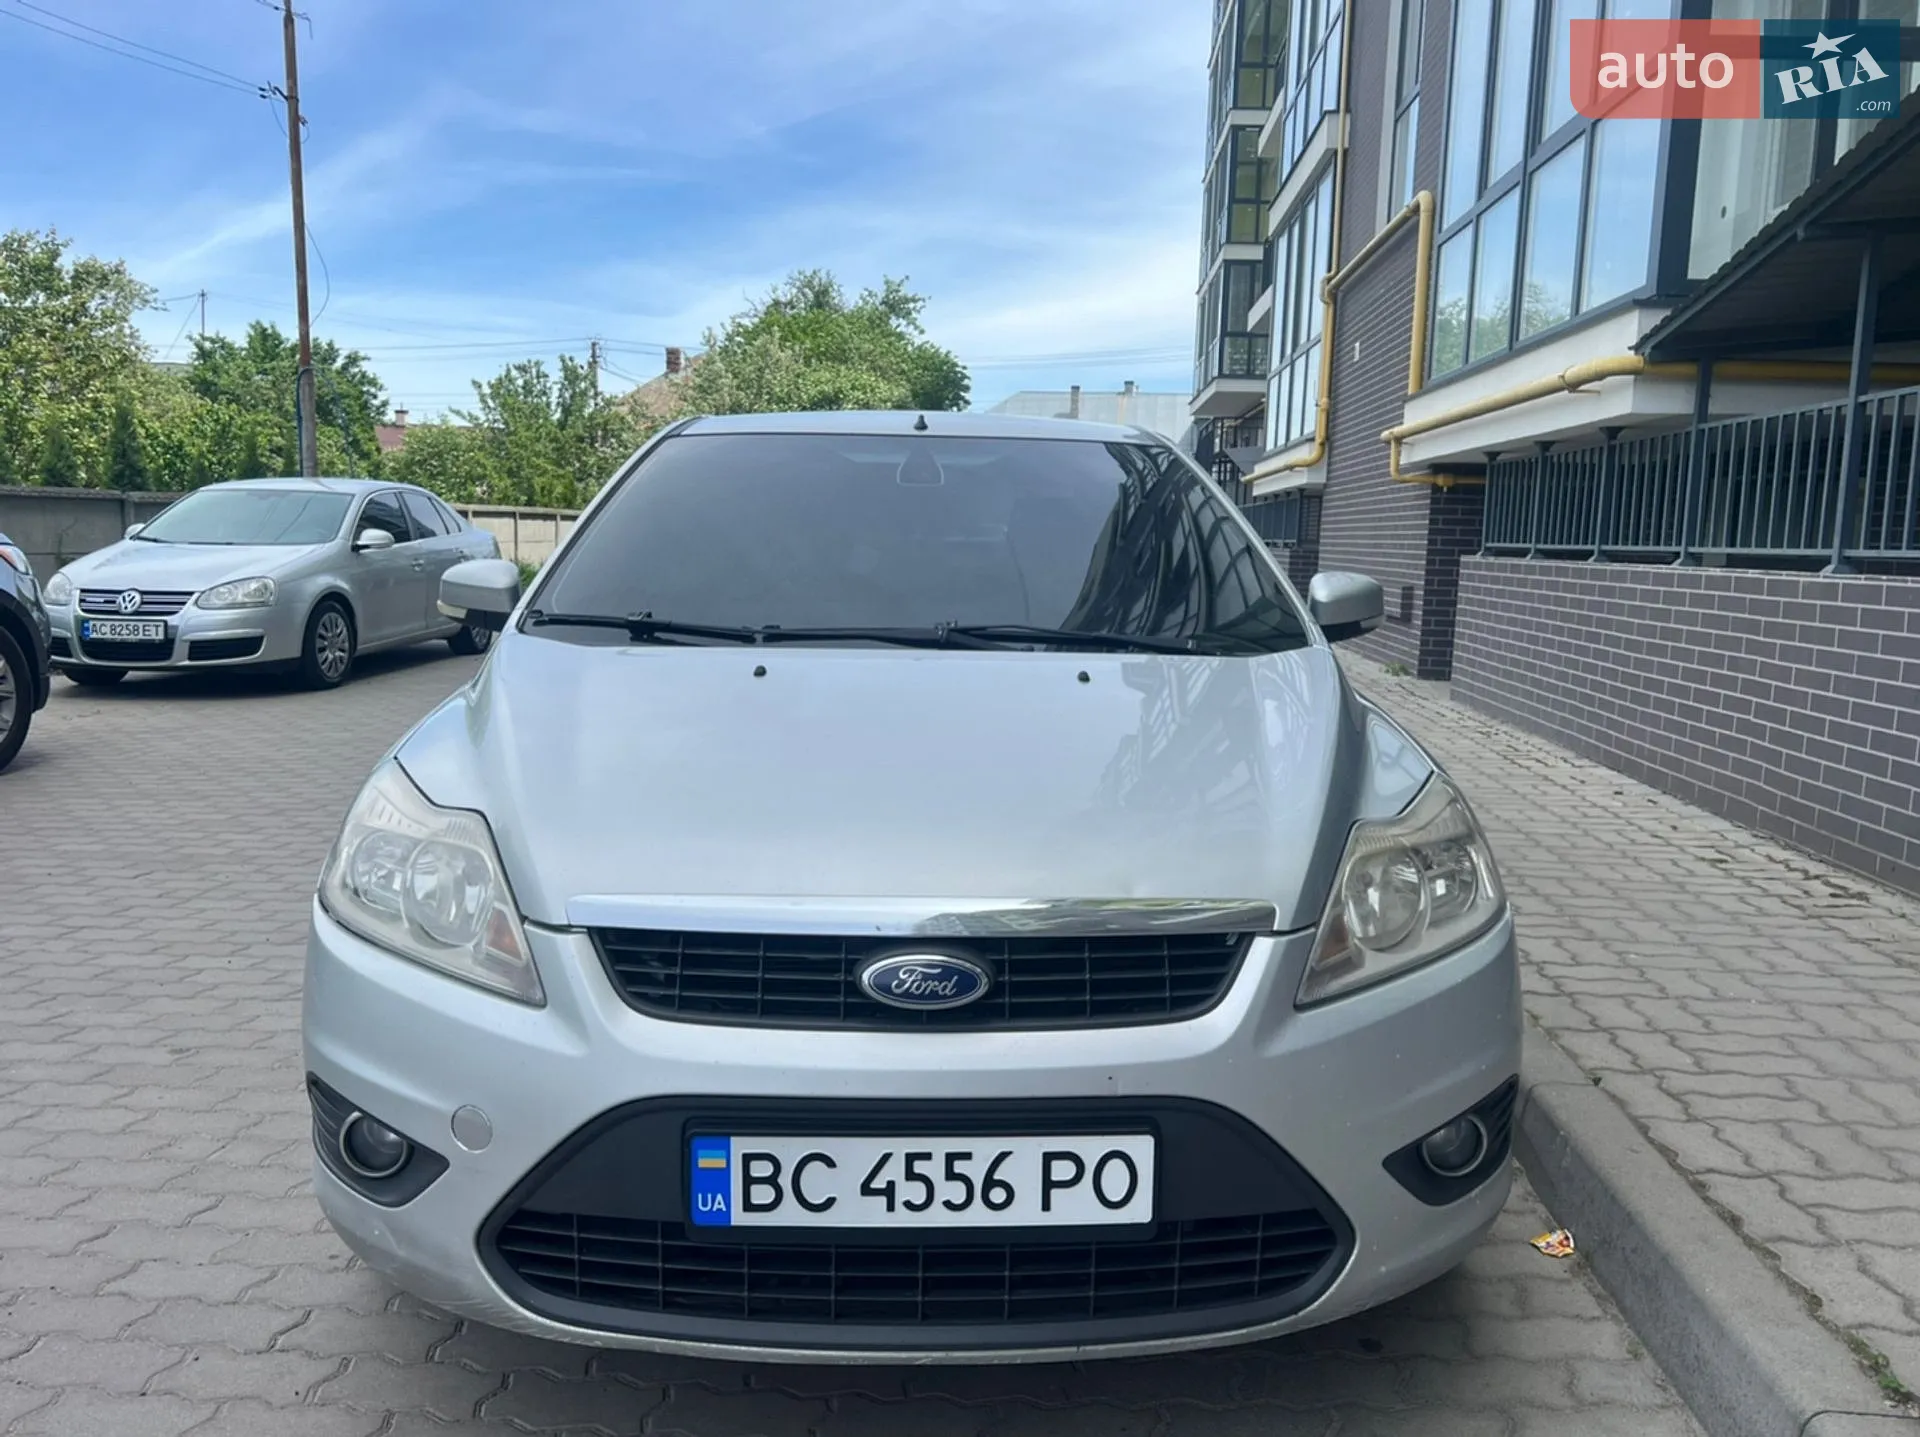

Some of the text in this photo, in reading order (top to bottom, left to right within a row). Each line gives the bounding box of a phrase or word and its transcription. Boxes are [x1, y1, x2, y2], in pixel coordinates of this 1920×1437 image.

[91, 623, 161, 637] AC 8258 ET
[891, 965, 959, 996] Ford
[741, 1149, 1139, 1213] BC 4556 PO
[697, 1193, 726, 1212] UA
